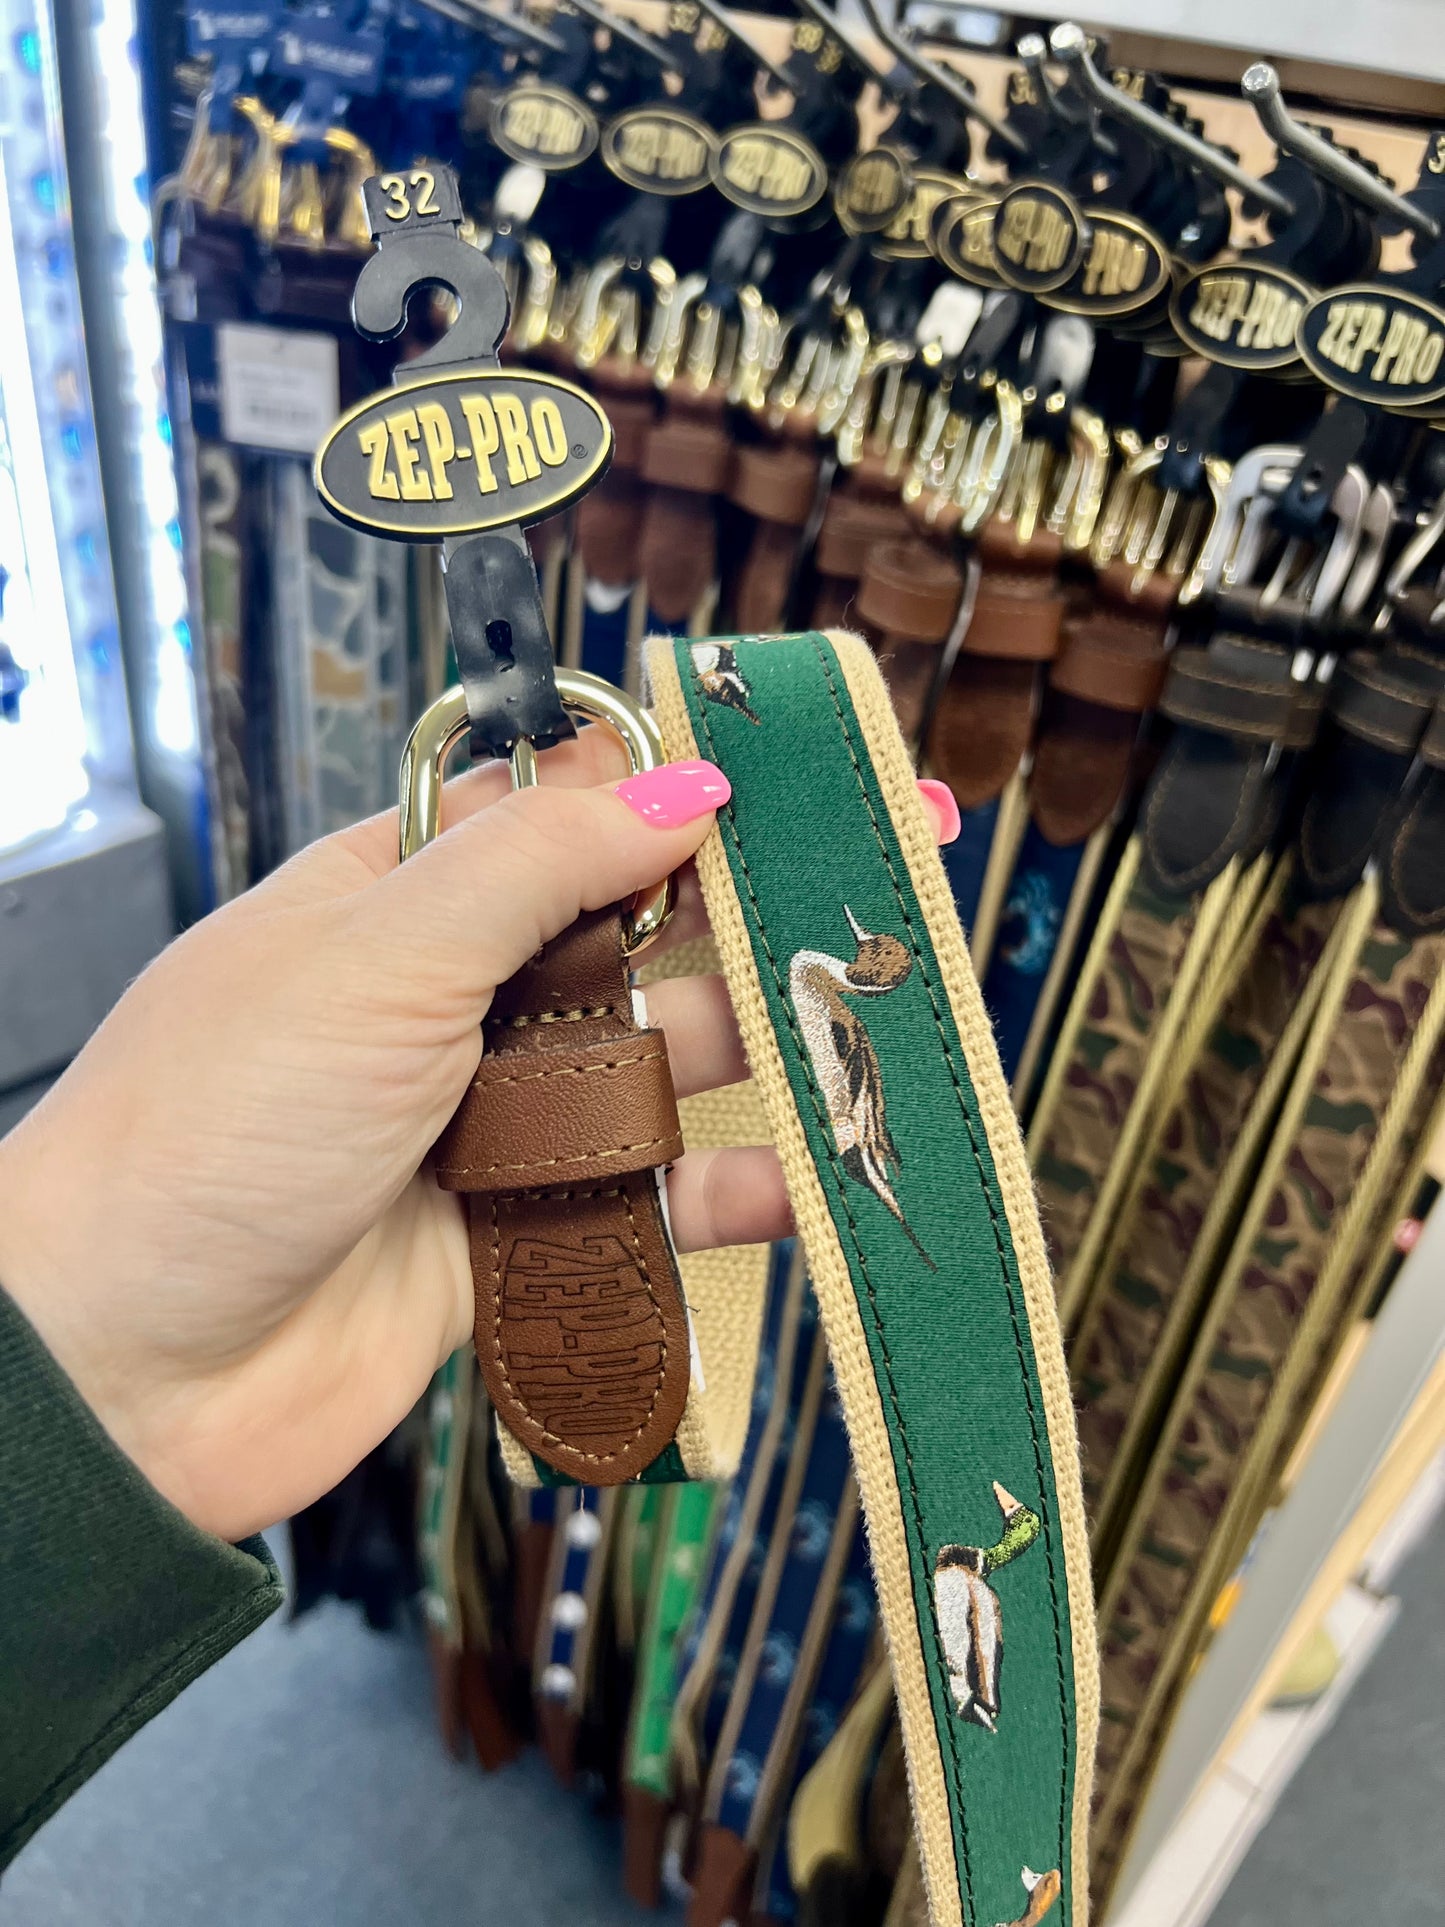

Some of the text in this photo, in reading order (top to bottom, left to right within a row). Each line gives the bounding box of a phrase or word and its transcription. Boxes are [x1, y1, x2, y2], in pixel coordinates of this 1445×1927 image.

[381, 171, 441, 221] 32
[1317, 301, 1445, 385] ZEP-PRO
[358, 391, 569, 502] ZEP-PRO
